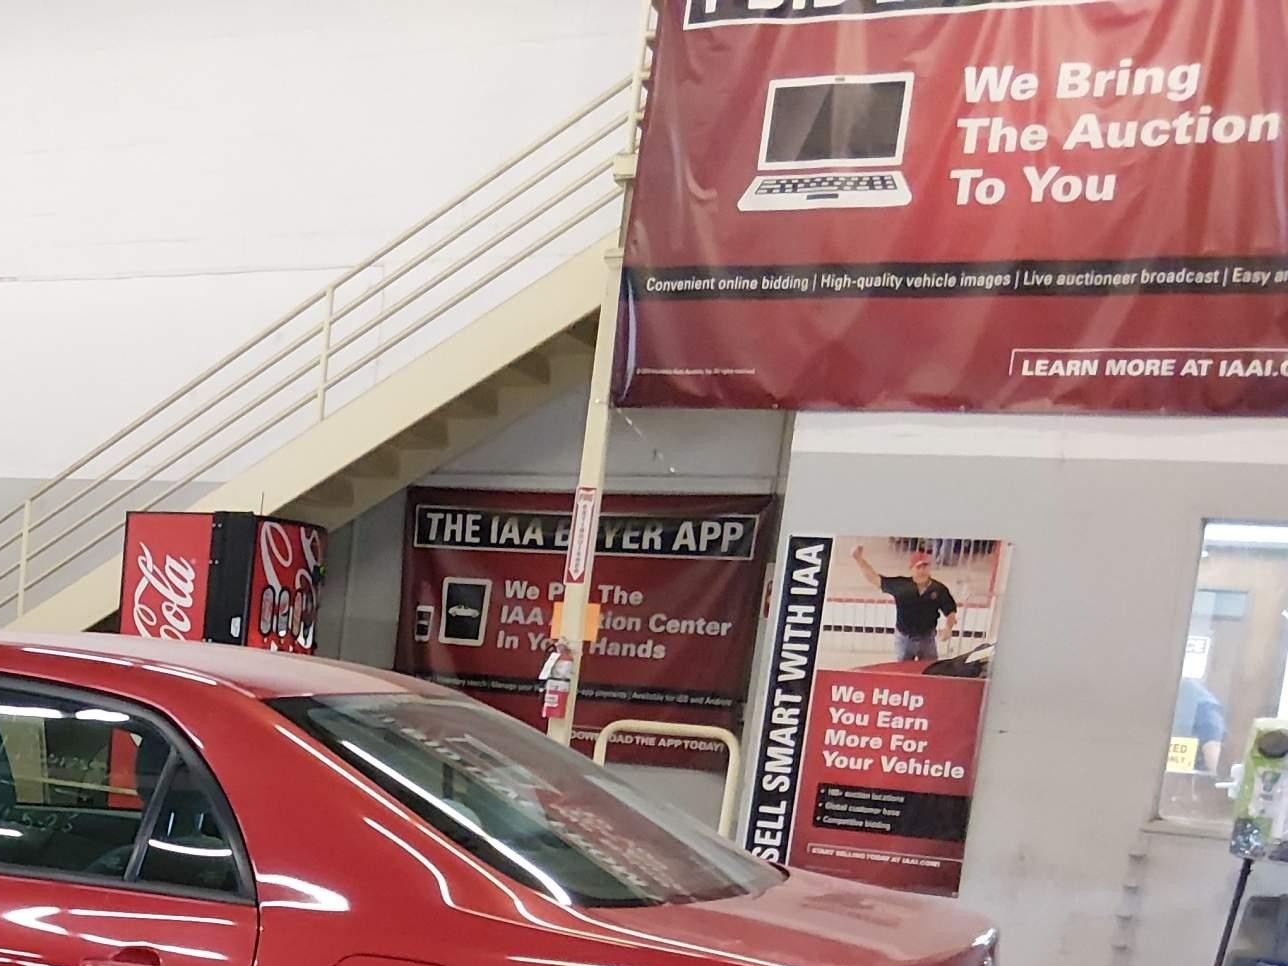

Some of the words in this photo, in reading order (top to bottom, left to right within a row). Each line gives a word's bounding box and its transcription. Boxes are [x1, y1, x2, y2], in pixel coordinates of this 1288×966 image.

[965, 66, 1039, 103] We
[1056, 58, 1201, 102] Bring
[957, 117, 1048, 154] The
[1063, 105, 1280, 151] Auction
[950, 168, 1006, 205] To
[1023, 165, 1117, 202] You
[646, 276, 715, 292] Convenient
[718, 275, 758, 291] online
[761, 274, 809, 292] bidding
[820, 272, 903, 291] High-quality
[906, 273, 956, 288] vehicle
[960, 271, 1011, 289] images
[1023, 269, 1053, 287] Live
[1056, 269, 1138, 286] auctioneer
[1140, 268, 1220, 285] broadcast
[1232, 267, 1272, 286] Easy
[1021, 359, 1098, 376] LEARN
[1105, 358, 1176, 376] MORE
[1180, 358, 1213, 376] AT
[426, 512, 482, 544] THE
[490, 515, 544, 546] IAA
[554, 518, 662, 551] BYER
[672, 521, 745, 553] APP
[790, 543, 825, 596] IAA
[504, 580, 540, 600] We
[598, 585, 643, 605] The
[500, 605, 544, 626] IAA
[649, 613, 733, 637] Center
[496, 631, 519, 650] In
[589, 638, 666, 660] Hands
[777, 604, 816, 683] WITH
[831, 685, 865, 703] We
[872, 688, 924, 711] Help
[828, 707, 869, 726] You
[876, 710, 928, 730] Earn
[635, 735, 656, 746] THE
[658, 738, 682, 749] APP
[762, 688, 803, 794] SMART
[824, 729, 883, 749] More
[890, 734, 928, 753] For
[823, 750, 874, 771] Your
[880, 755, 965, 779] Vehicle
[752, 800, 787, 864] SELL
